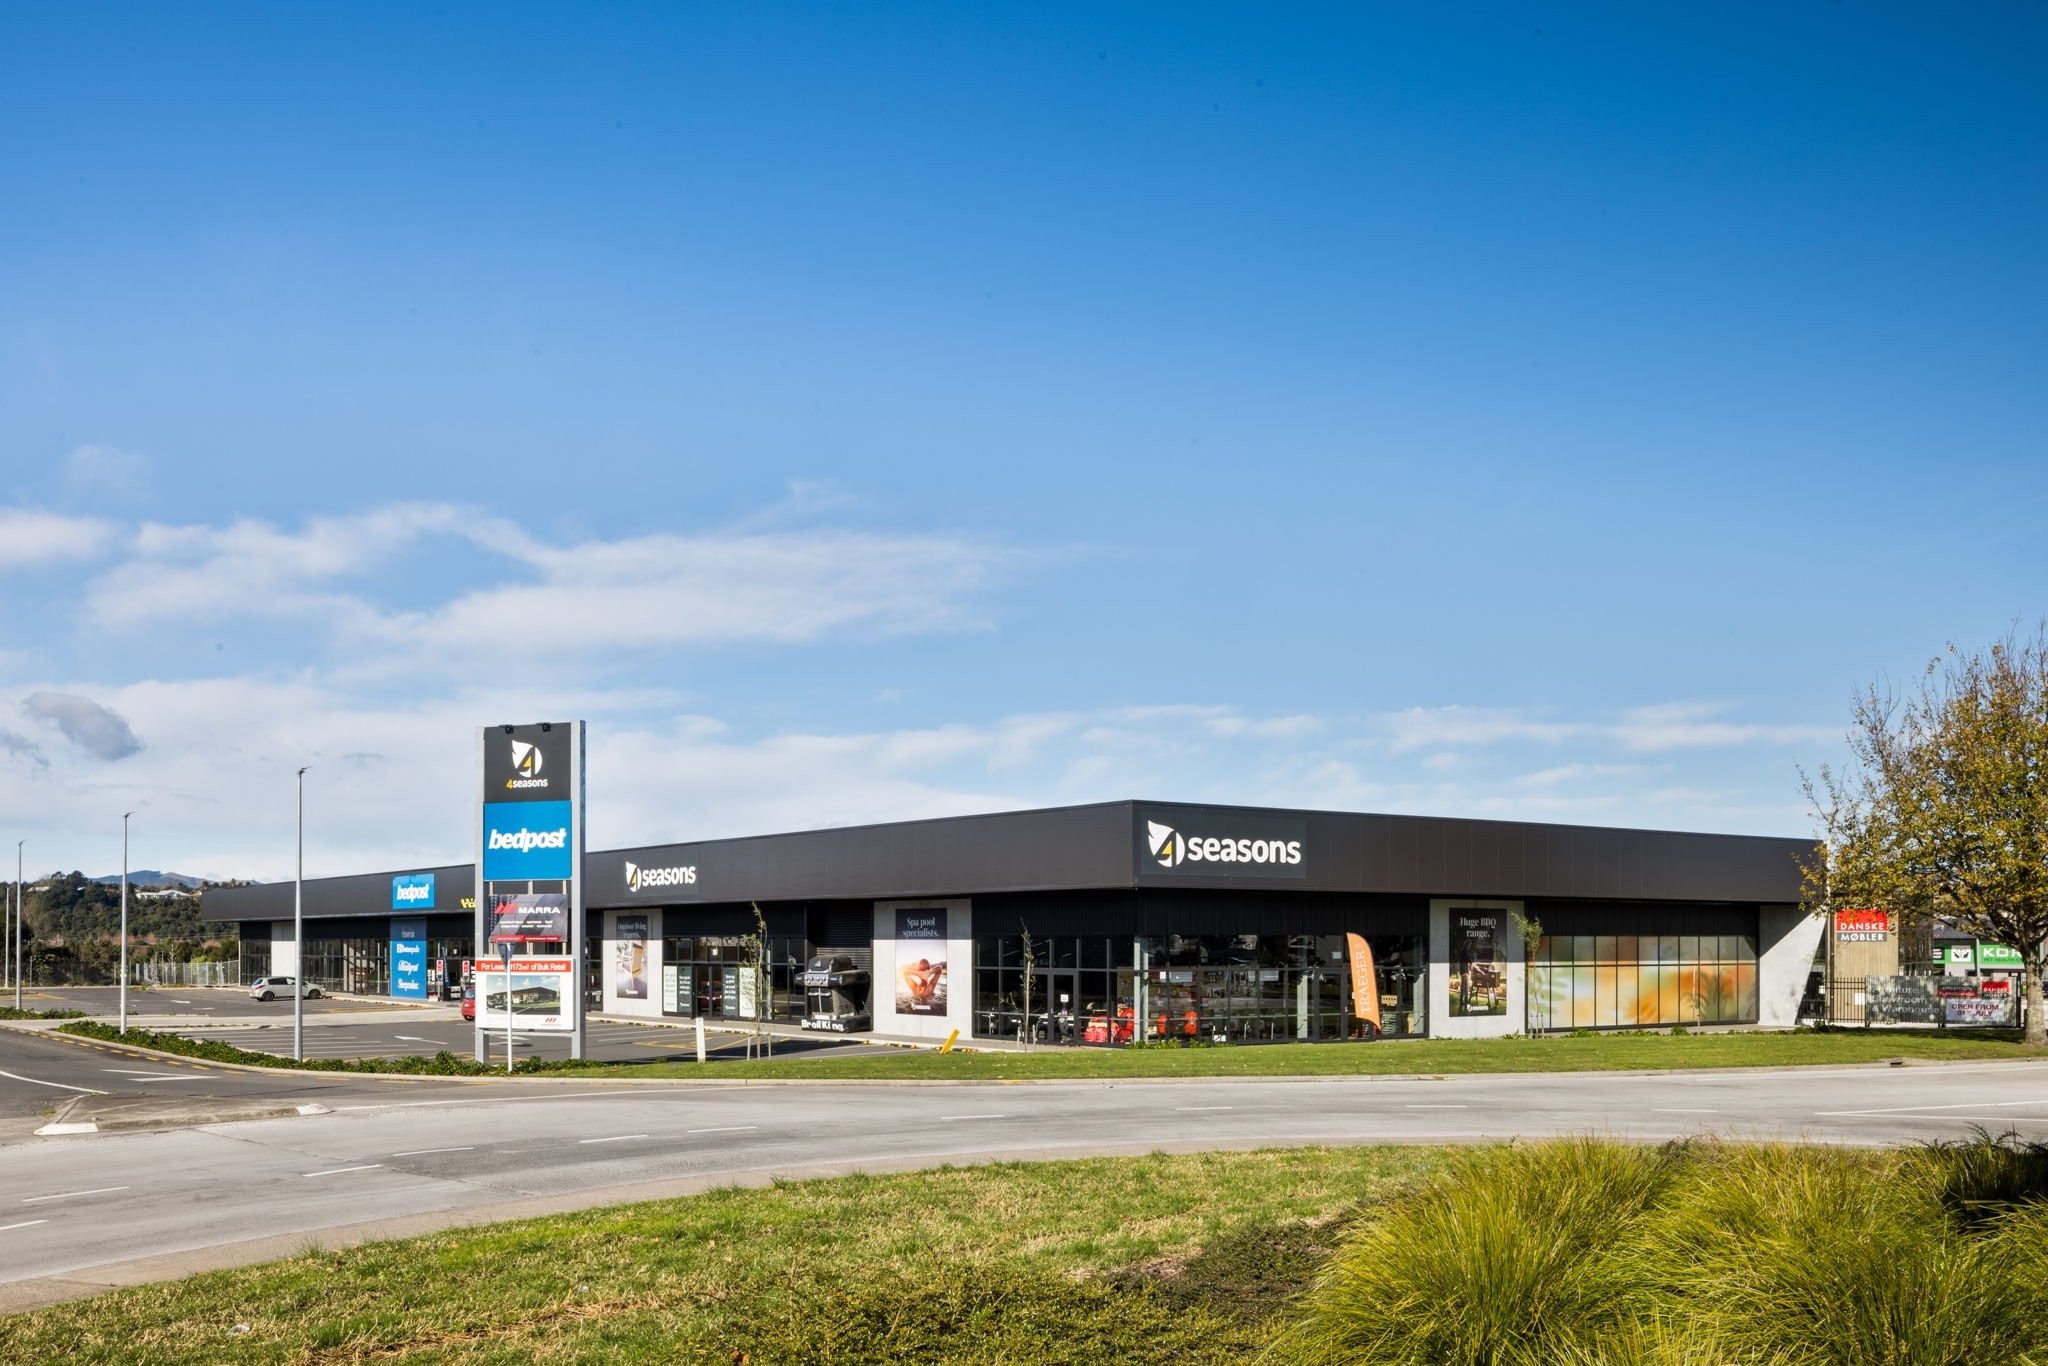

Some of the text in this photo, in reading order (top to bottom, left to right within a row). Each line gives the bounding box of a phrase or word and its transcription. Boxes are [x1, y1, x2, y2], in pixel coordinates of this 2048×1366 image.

[506, 779, 549, 790] 4seasons
[488, 828, 567, 853] bedpost
[397, 883, 430, 903] bedpost
[518, 906, 561, 914] MARRA
[907, 916, 936, 928] Spa pool
[1460, 917, 1497, 929] Huge BBQ
[1841, 922, 1884, 930] DANSKE
[902, 928, 940, 939] specialists.
[1466, 930, 1490, 940] range.
[1841, 933, 1884, 941] MØBLER
[1983, 947, 2022, 957] KOR
[481, 962, 490, 970] For
[491, 962, 505, 970] Leas
[537, 962, 550, 970] Bulk
[550, 962, 567, 970] Retail
[1355, 951, 1372, 1014] TRAEGER
